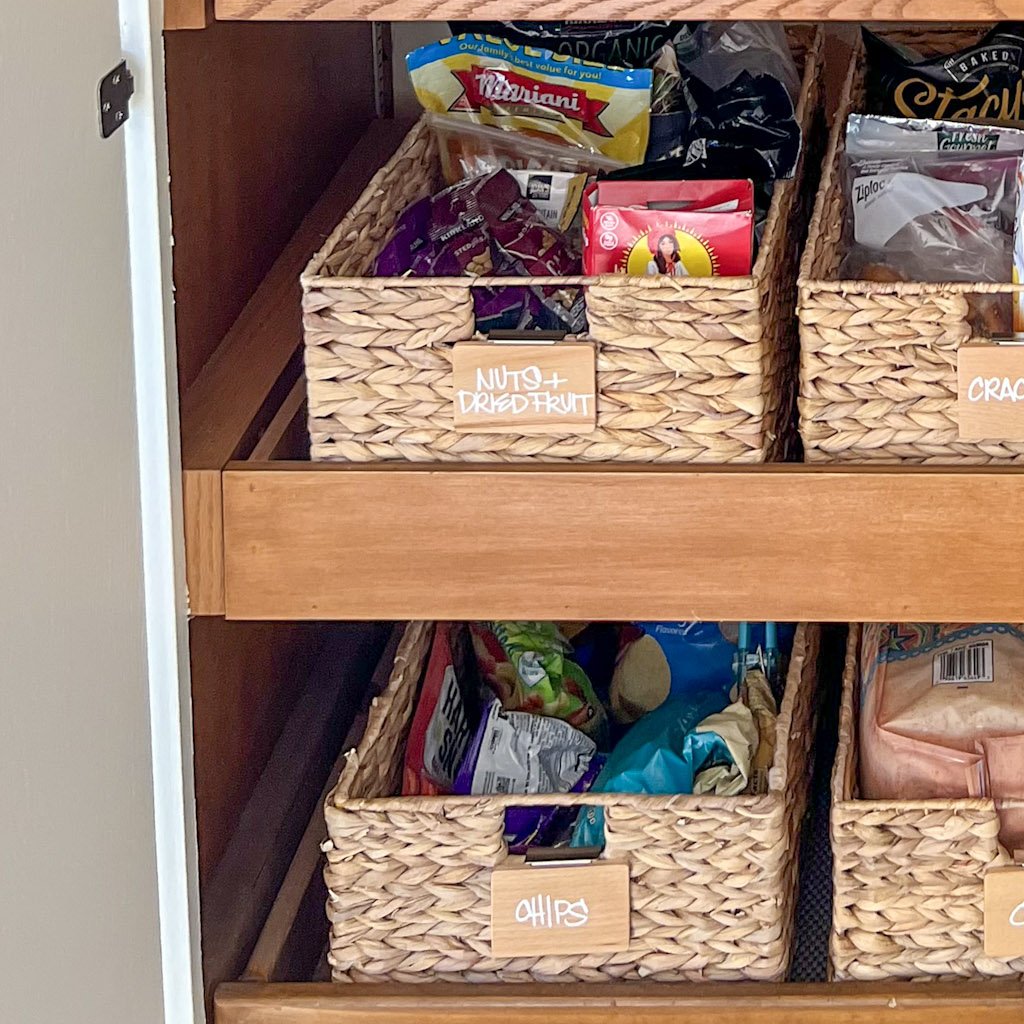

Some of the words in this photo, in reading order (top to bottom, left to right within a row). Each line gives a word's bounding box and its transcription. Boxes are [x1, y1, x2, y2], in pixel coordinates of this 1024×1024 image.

[459, 42, 477, 51] Our
[514, 56, 533, 68] best
[535, 63, 561, 74] value
[563, 66, 577, 76] for
[959, 51, 1009, 72] BAKED
[475, 72, 581, 111] Mariani
[855, 179, 885, 204] Ziploc
[458, 390, 529, 415] DRIED
[528, 392, 594, 416] FRUIT
[515, 894, 589, 928] CHIPS
